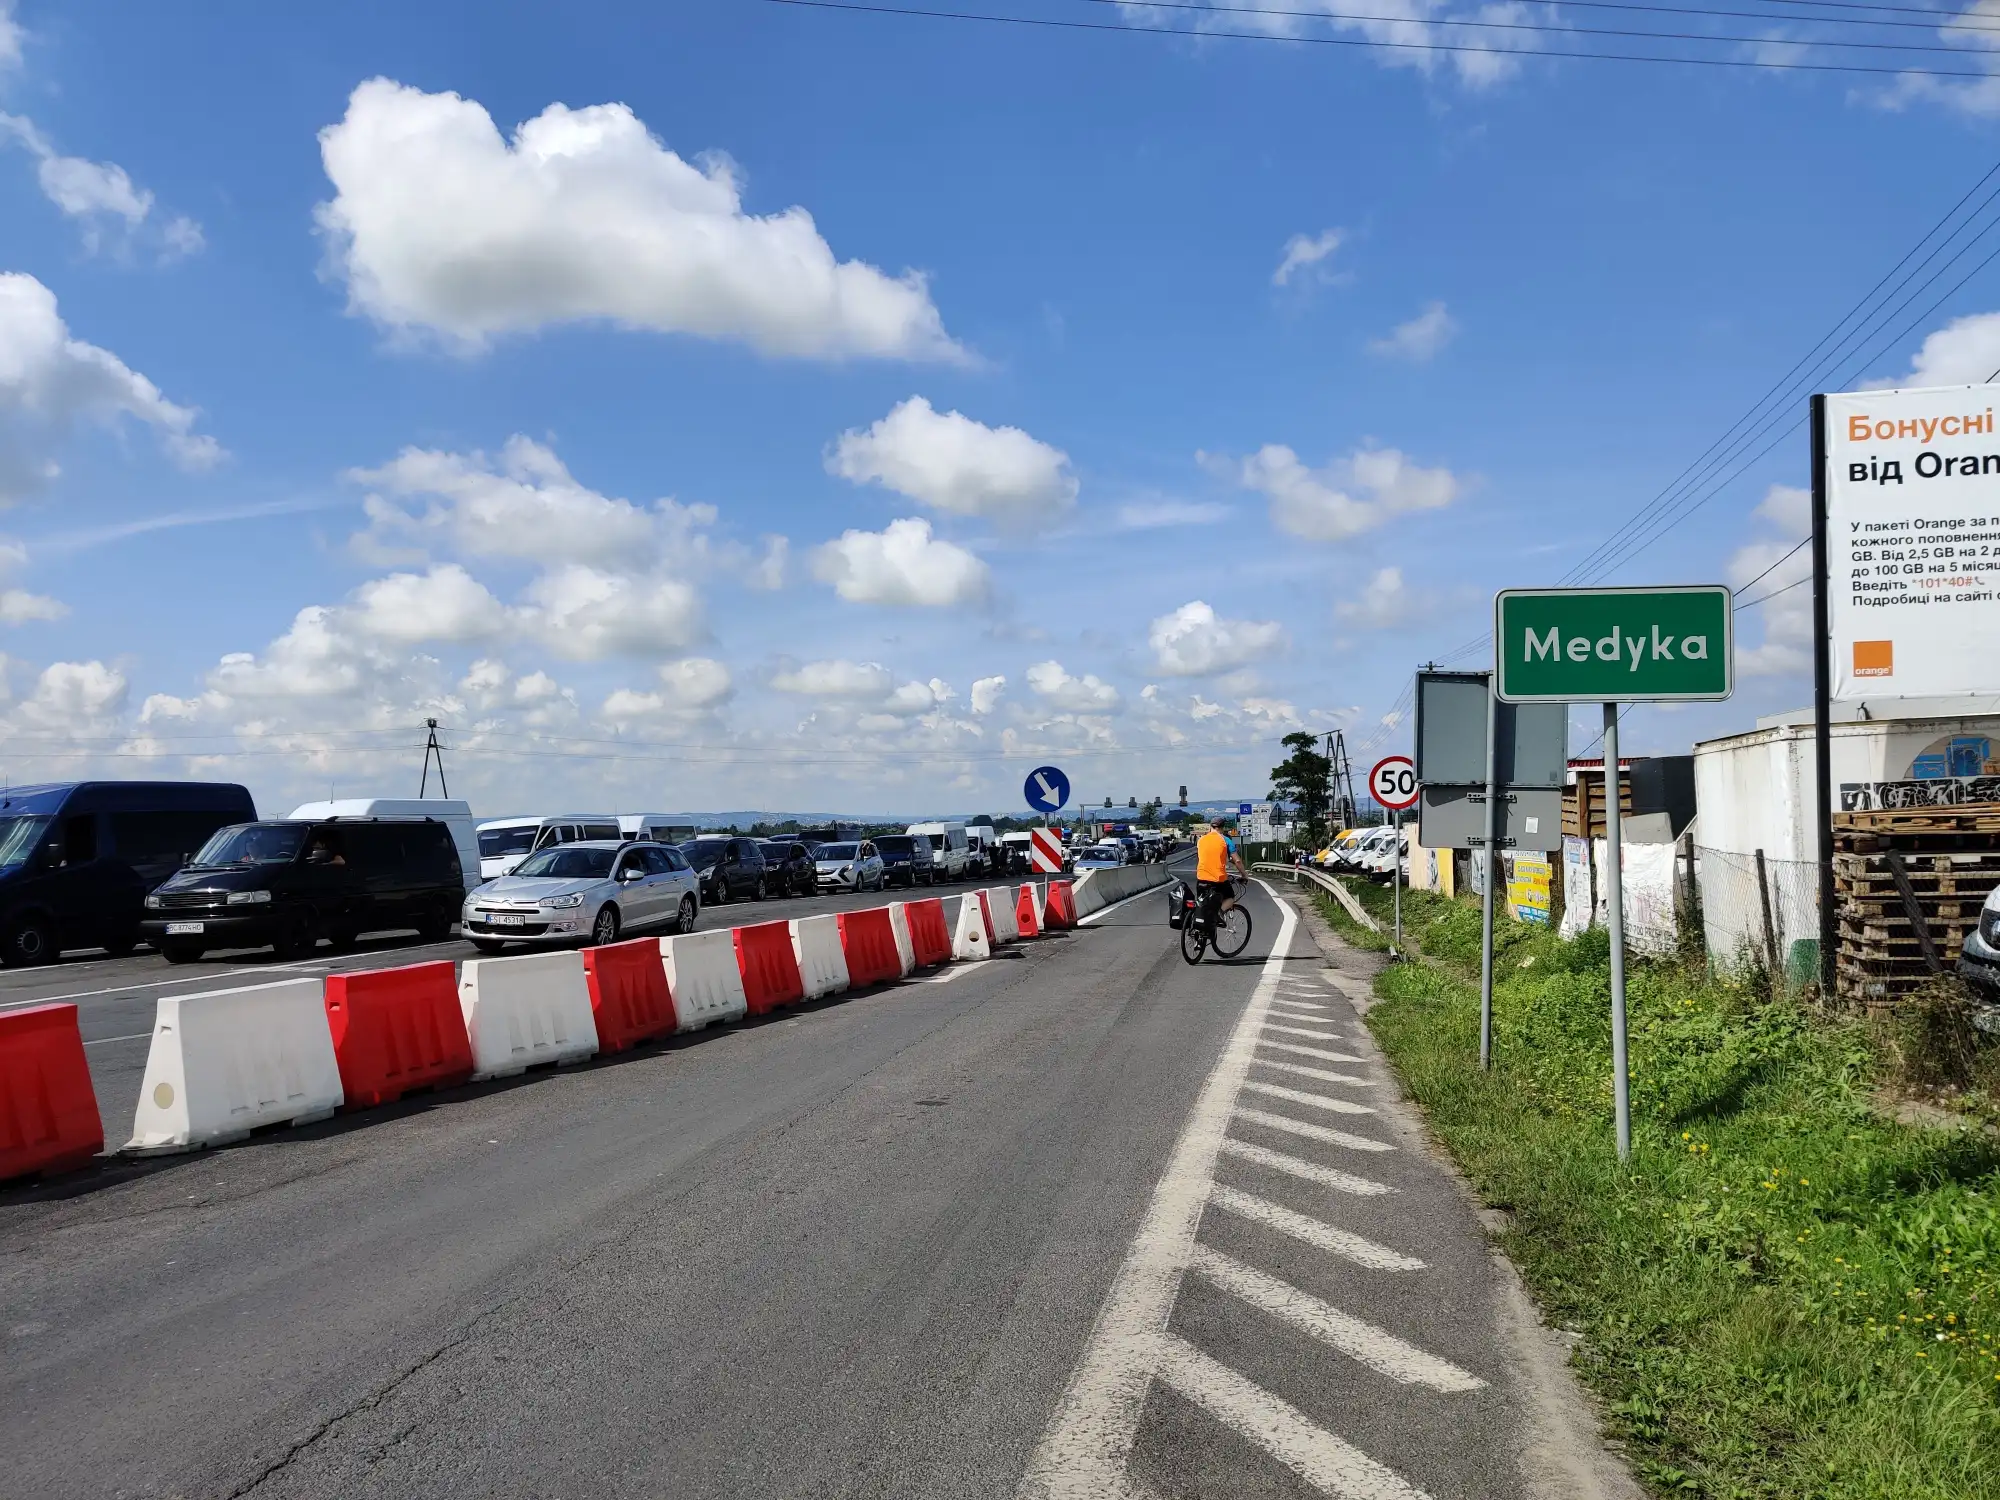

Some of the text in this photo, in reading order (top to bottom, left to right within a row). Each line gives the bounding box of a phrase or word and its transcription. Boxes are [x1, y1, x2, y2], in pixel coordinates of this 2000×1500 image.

[1849, 407, 1993, 443] Бонусні
[1849, 452, 2000, 485] від Oran
[1851, 521, 1860, 532] У
[1865, 520, 1909, 532] пакеті
[1914, 518, 1965, 530] Orange
[1970, 518, 1986, 526] за
[1852, 536, 1914, 547] кожного
[1852, 551, 1877, 561] GB.
[1881, 549, 1904, 561] Від
[1908, 548, 1929, 560] 2,5
[1933, 547, 1954, 558] GB
[1960, 548, 1976, 557] на
[1981, 546, 1989, 556] 2
[1851, 567, 1870, 578] до
[1874, 564, 1898, 575] 100
[1903, 563, 1924, 574] GB
[1928, 564, 1945, 573] на
[1949, 561, 1958, 572] 5
[1852, 580, 1908, 592] Введіть
[1853, 592, 1930, 607] Подробиці
[1934, 594, 1951, 603] на
[1955, 590, 1992, 601] сайті
[1524, 625, 1708, 672] Medyka
[1855, 667, 1890, 676] orange
[1380, 770, 1415, 795] 50
